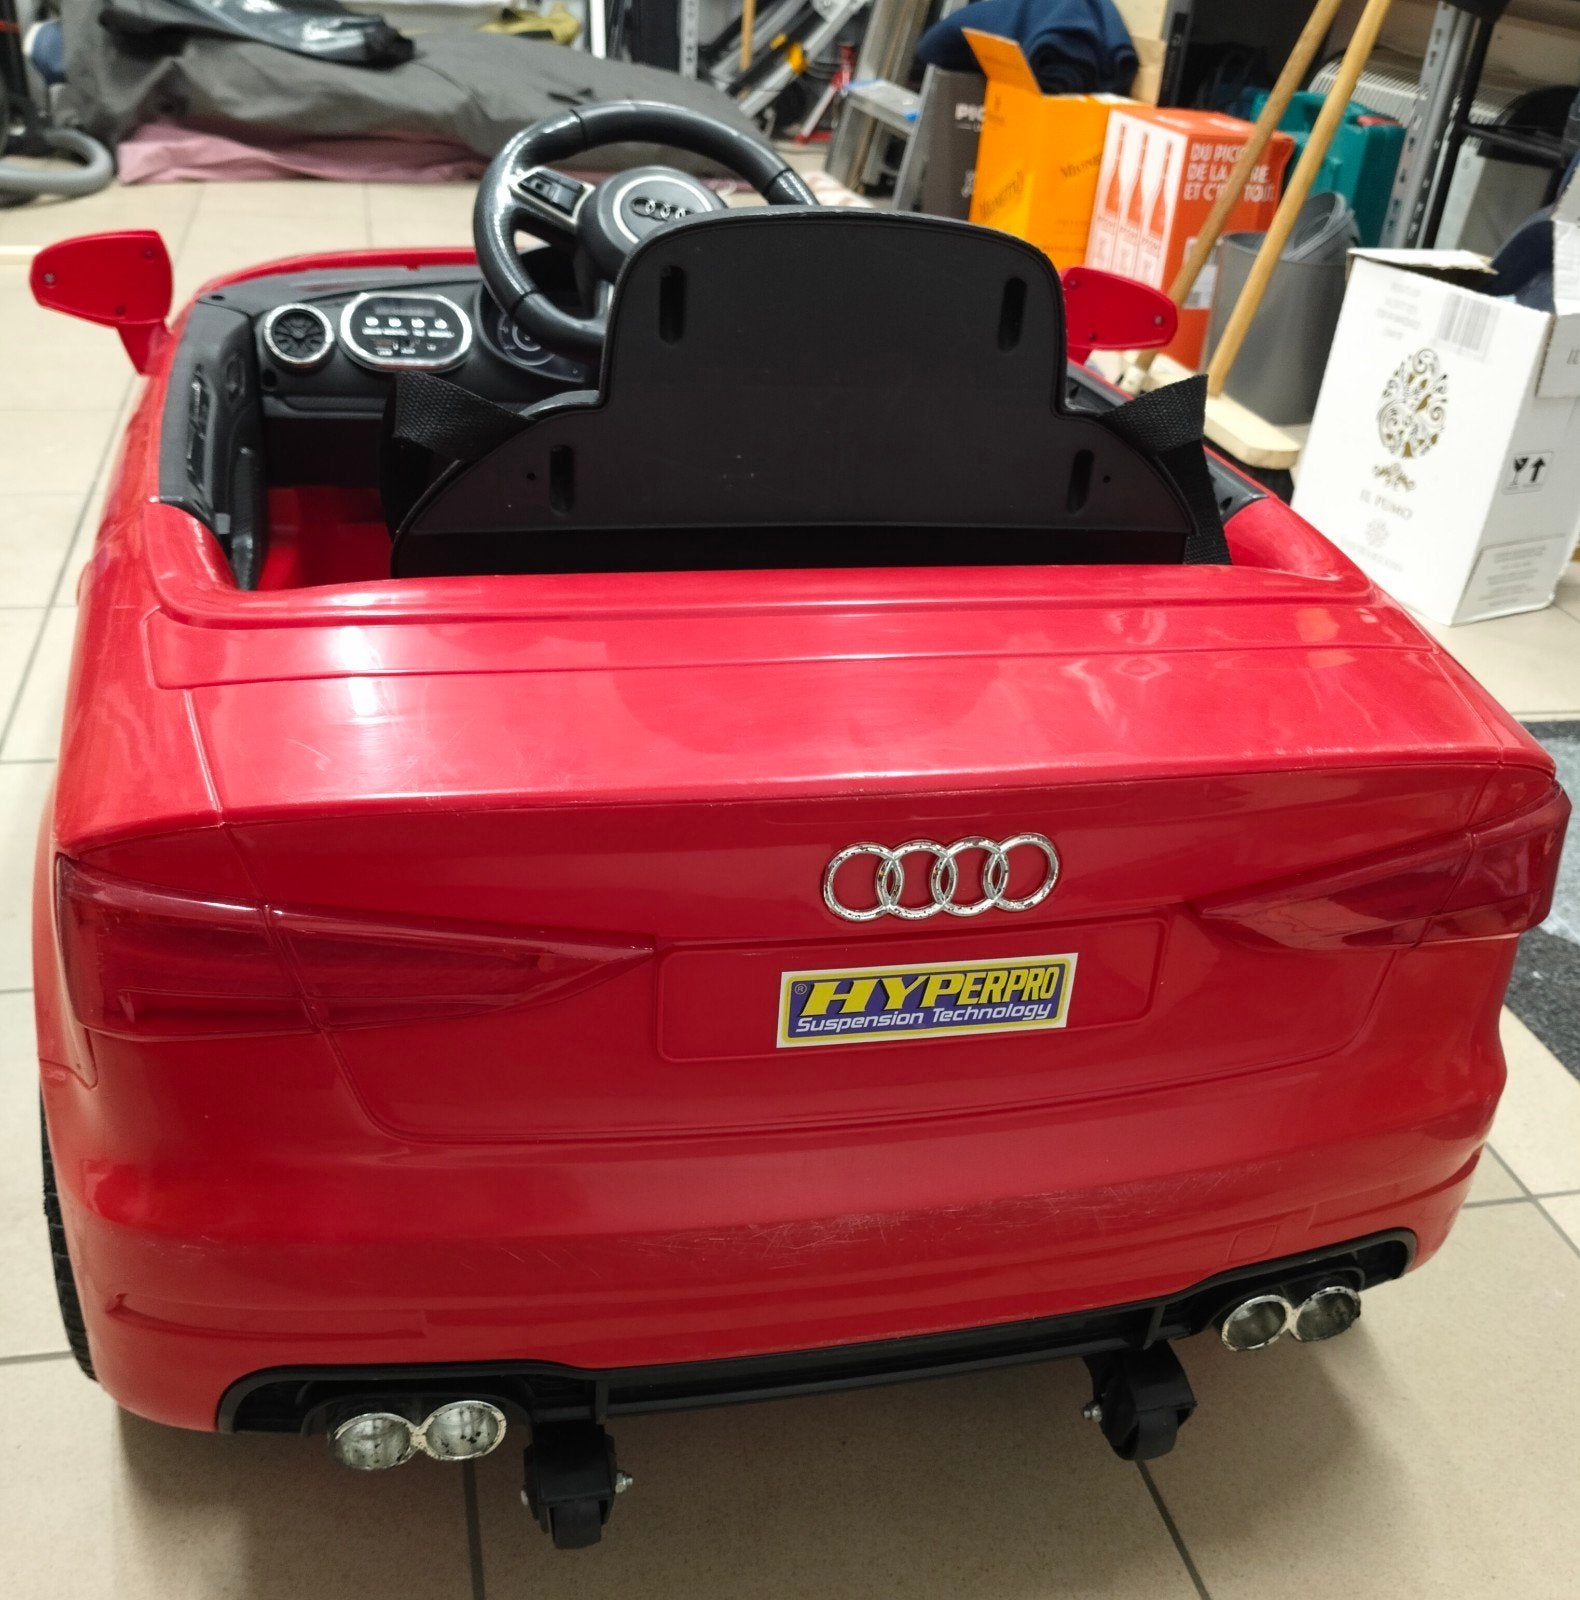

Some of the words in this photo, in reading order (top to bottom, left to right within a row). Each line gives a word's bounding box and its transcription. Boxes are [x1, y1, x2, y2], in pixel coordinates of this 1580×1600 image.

[800, 965, 1061, 1016] HYPERPRO
[796, 1011, 924, 1033] Suspension
[932, 1003, 1052, 1021] Technology
